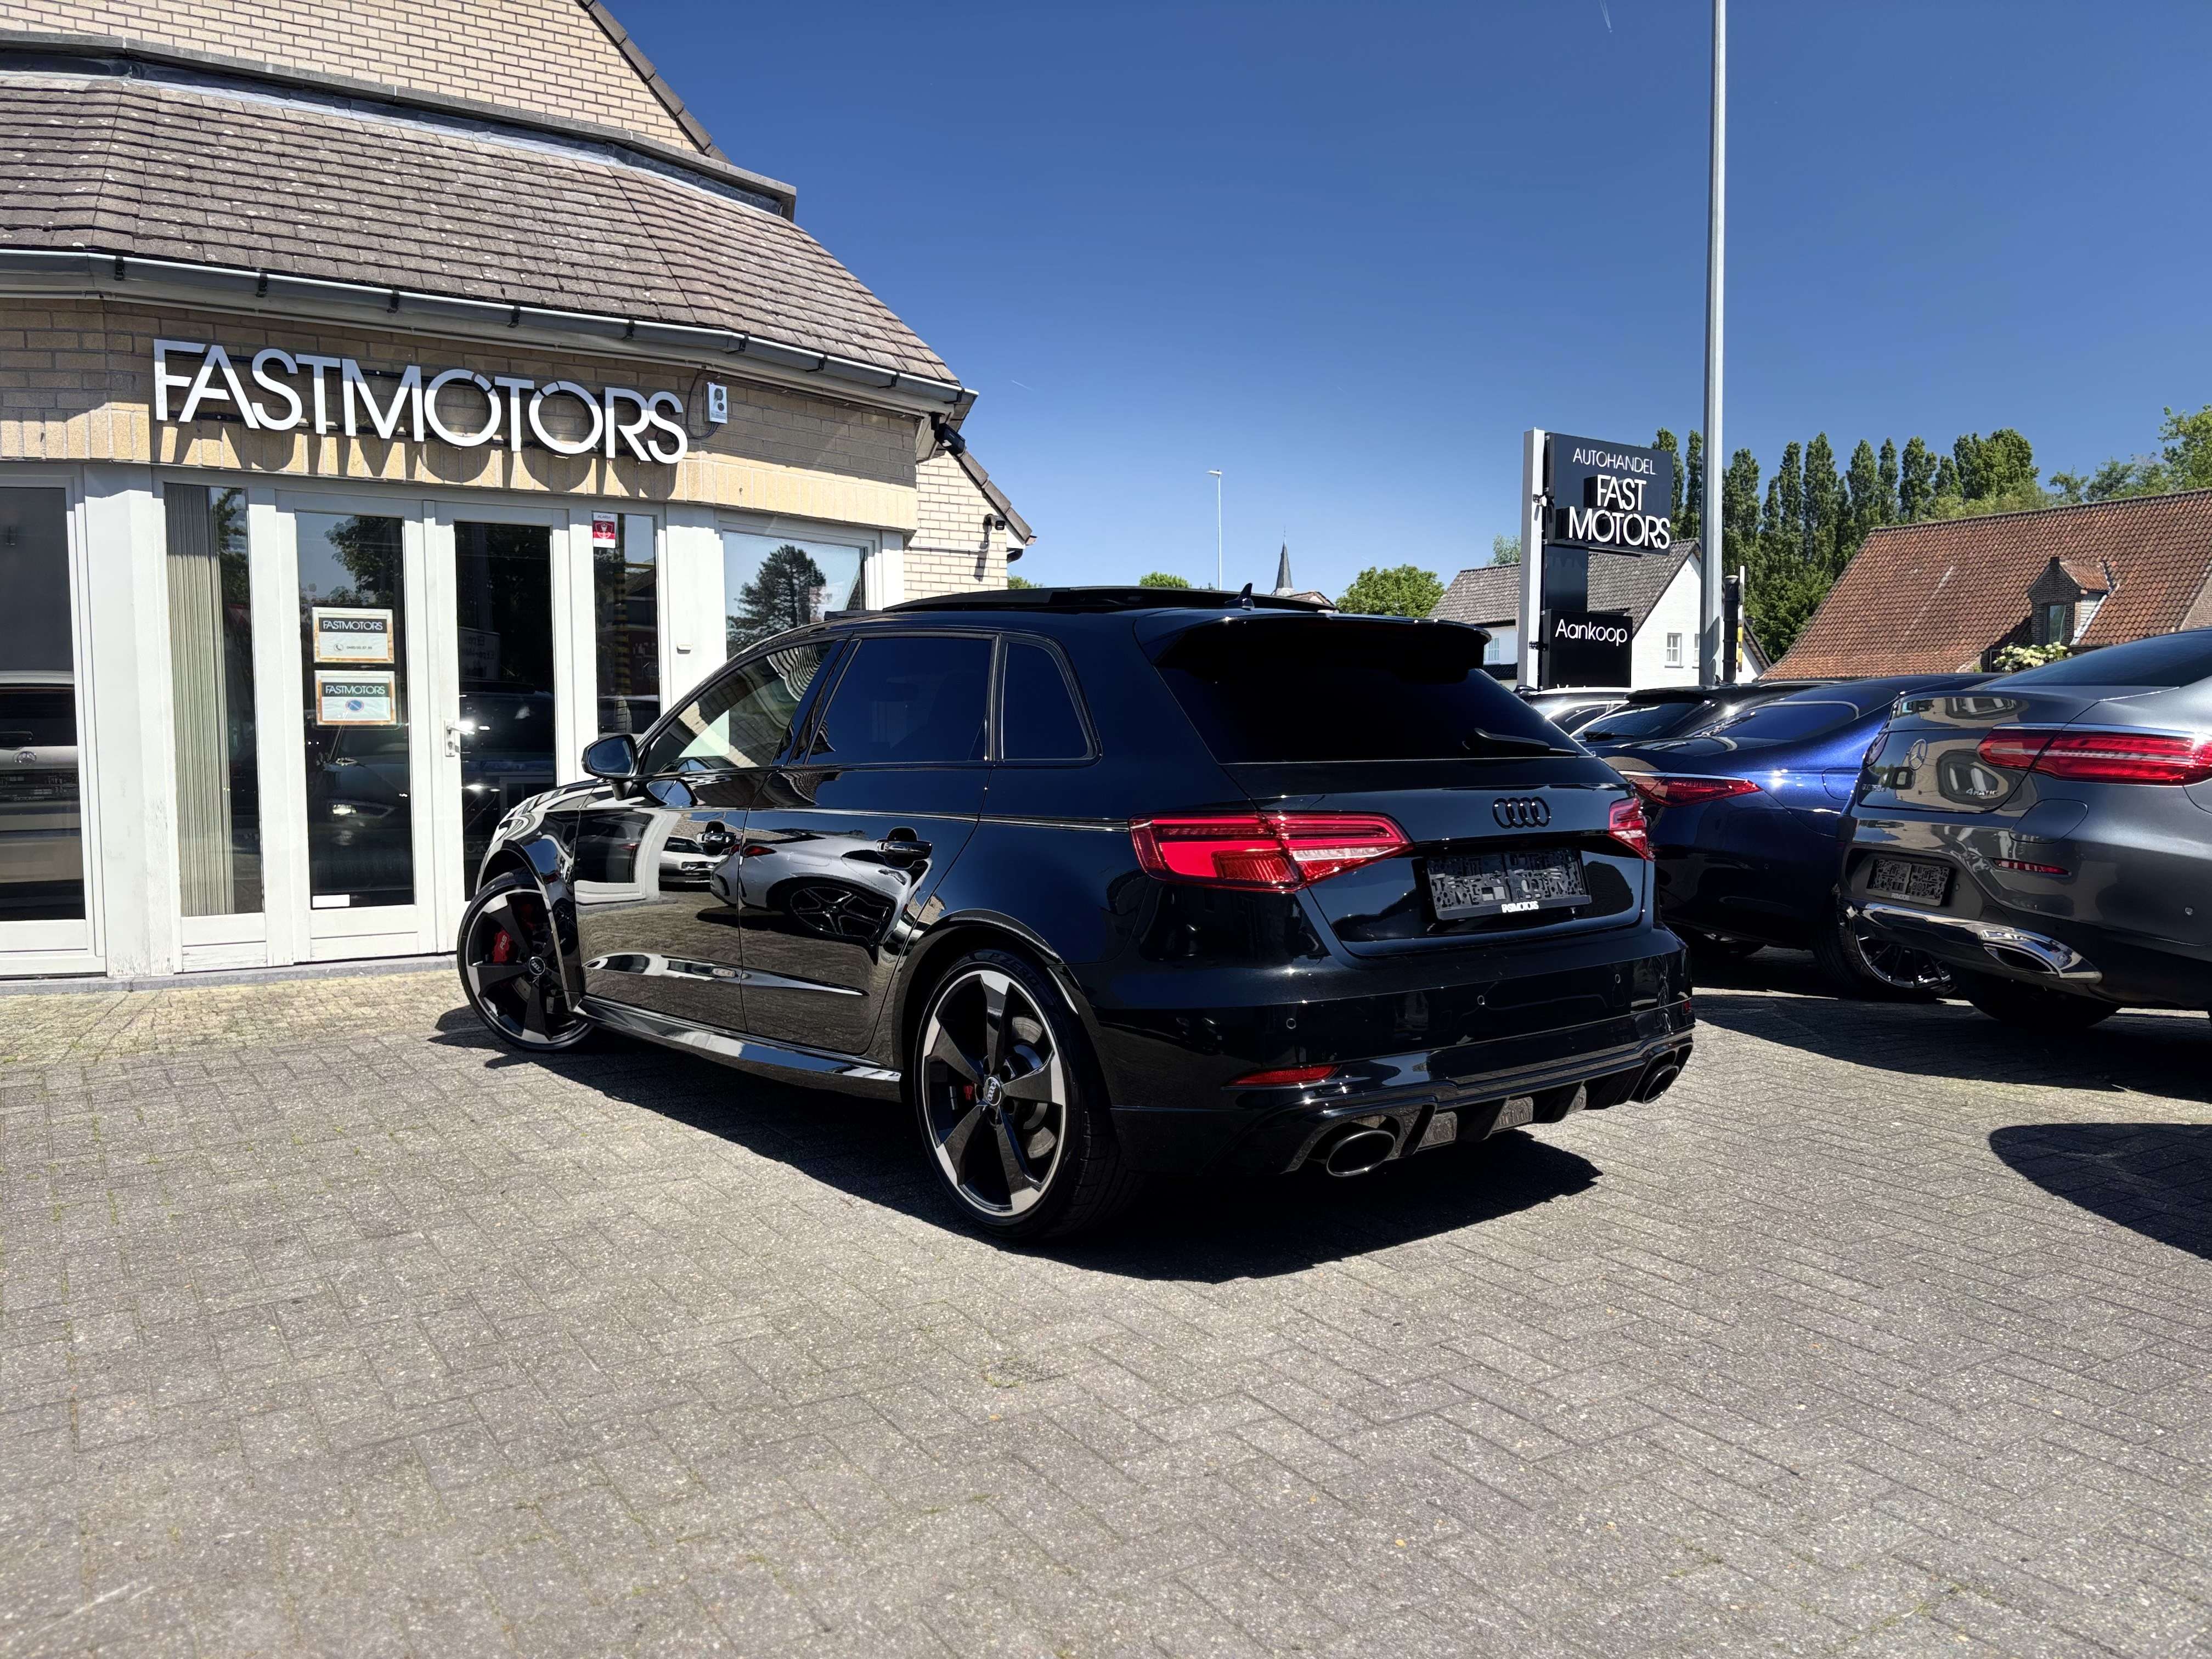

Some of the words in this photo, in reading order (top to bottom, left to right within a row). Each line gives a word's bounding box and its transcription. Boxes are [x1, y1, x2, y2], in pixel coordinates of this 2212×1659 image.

[154, 338, 688, 464] FASTMOTORS
[1572, 448, 1656, 476] AUTOHANDEL
[1597, 475, 1647, 511] FAST
[1568, 506, 1671, 549] MOTORS
[323, 620, 383, 630] FASTMOTORS
[1555, 619, 1628, 646] Aankoop
[325, 686, 385, 695] FASTMOTORS
